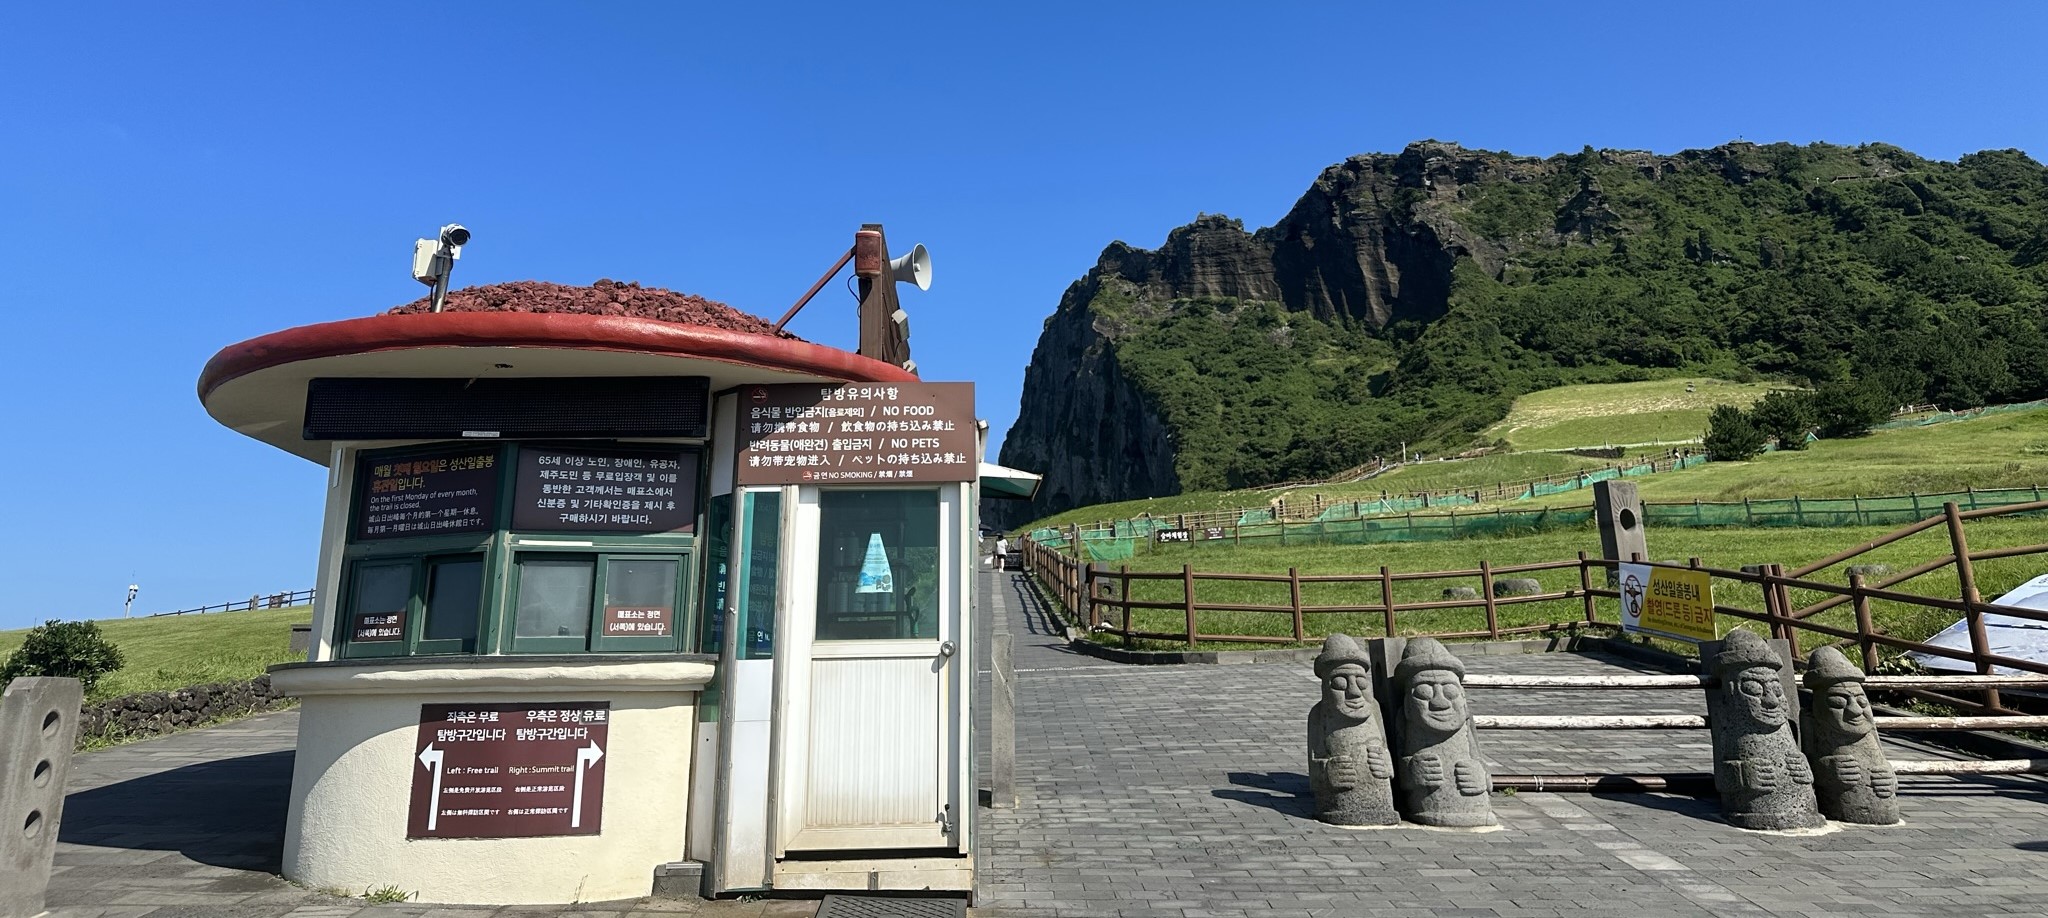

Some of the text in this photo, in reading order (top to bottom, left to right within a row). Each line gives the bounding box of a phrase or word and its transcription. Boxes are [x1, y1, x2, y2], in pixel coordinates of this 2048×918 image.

[821, 387, 898, 400] 탐방유의사항
[750, 407, 781, 418] 음식물
[870, 406, 876, 417] /
[883, 406, 900, 416] NO
[904, 406, 934, 416] FOOD
[828, 422, 834, 433] /
[841, 420, 955, 432] 飲食物の持ち込み禁止
[750, 438, 940, 452] 반려동물(애완견) 출입금지 / NO PETS
[538, 456, 680, 470] 65세 이상 노인, 장애인, 유공자,
[838, 454, 844, 466] /
[852, 452, 966, 465] ペットの持ち込み禁止
[374, 464, 392, 478] 매월
[450, 454, 494, 471] 성산일출봉
[540, 470, 678, 483] 제주도민 등 무료입장객 및 이를
[405, 492, 429, 500] Monday
[456, 488, 478, 496] month,
[542, 484, 672, 497] 동반한 고객께서는 매표소에서
[380, 502, 392, 510] trail
[537, 498, 676, 510] 신분증 및 기타확인증을 제시 후
[559, 513, 652, 524] 구매하시기 바랍니다.
[1652, 578, 1700, 602] 성산일출봉내
[617, 610, 661, 618] 매표소는 정면
[1694, 606, 1713, 626] 금지
[446, 711, 500, 724] 좌측은 무료
[526, 710, 606, 722] 우측은 정상 유료
[437, 728, 506, 742] 탐방구간입니다
[516, 727, 588, 740] 탐방구간입니다
[508, 766, 528, 776] Right
